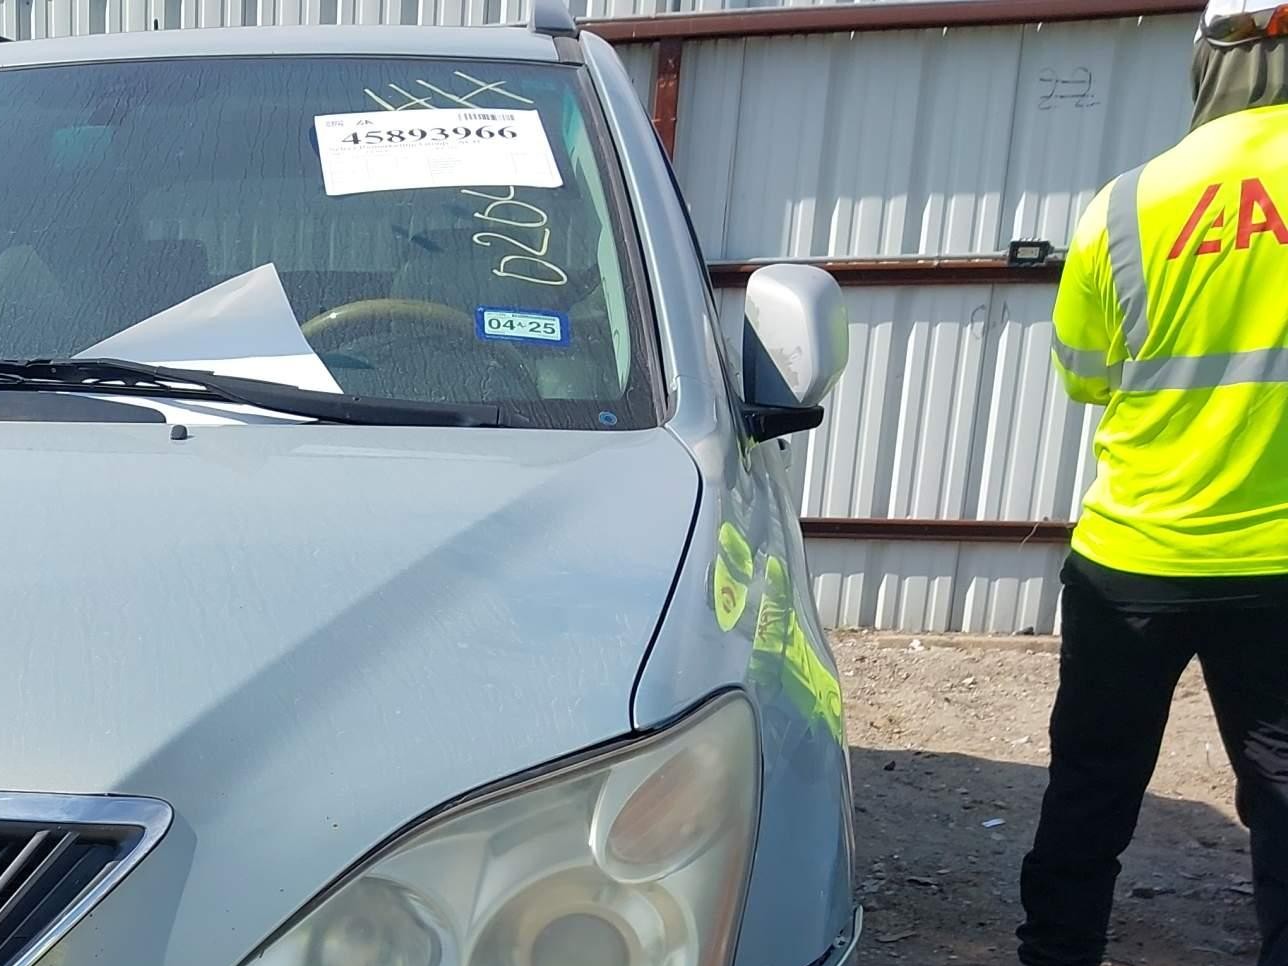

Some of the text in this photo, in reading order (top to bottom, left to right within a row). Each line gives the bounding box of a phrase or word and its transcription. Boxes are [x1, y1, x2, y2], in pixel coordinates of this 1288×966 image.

[341, 125, 518, 145] 45893966
[488, 318, 556, 335] 04 25
